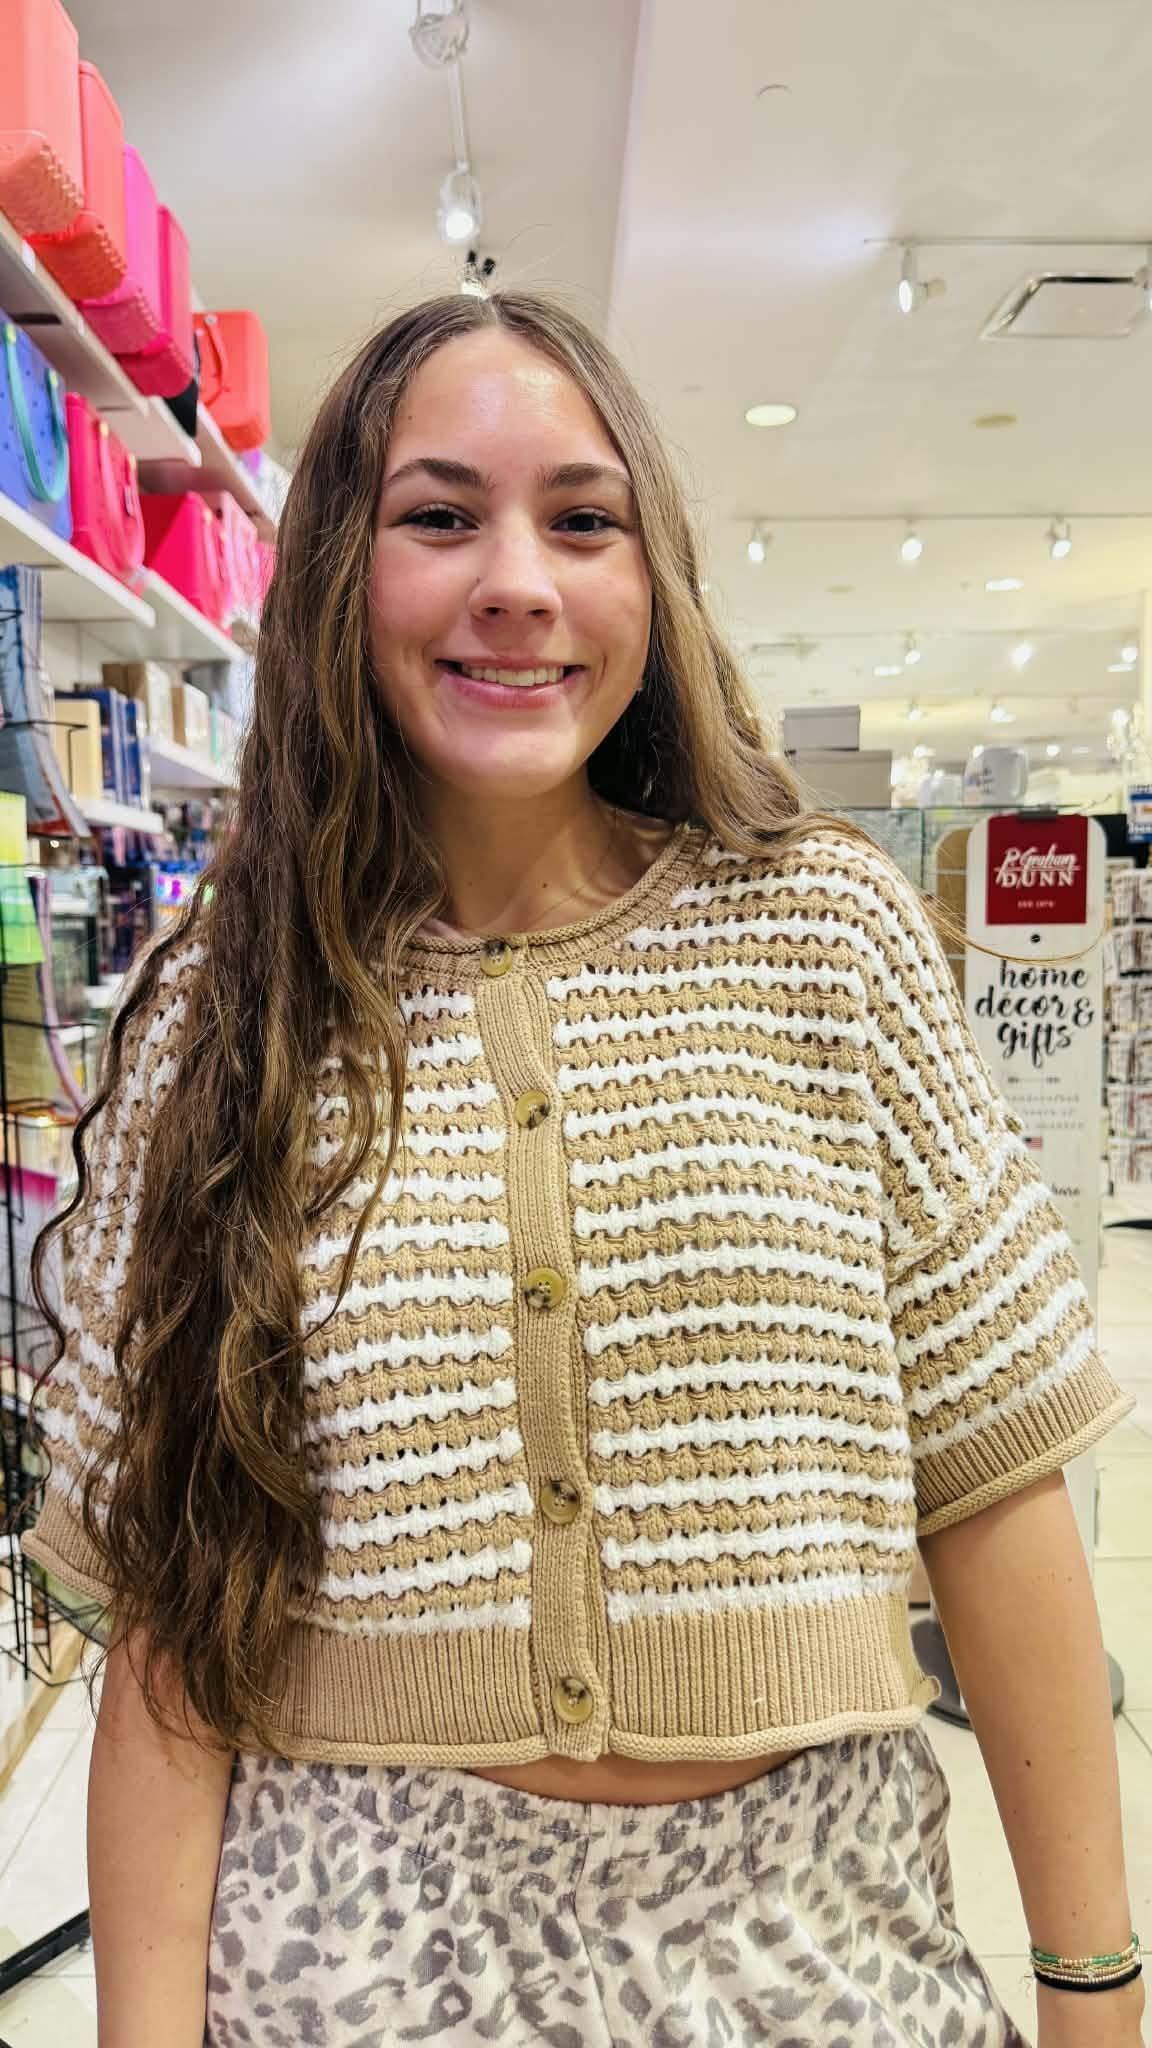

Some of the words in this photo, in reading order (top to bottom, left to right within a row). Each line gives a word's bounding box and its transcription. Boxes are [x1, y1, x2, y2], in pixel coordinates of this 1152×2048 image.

[1001, 870, 1074, 888] DUNN
[1000, 959, 1088, 989] home
[1071, 997, 1094, 1028] &
[997, 1022, 1072, 1068] gifts
